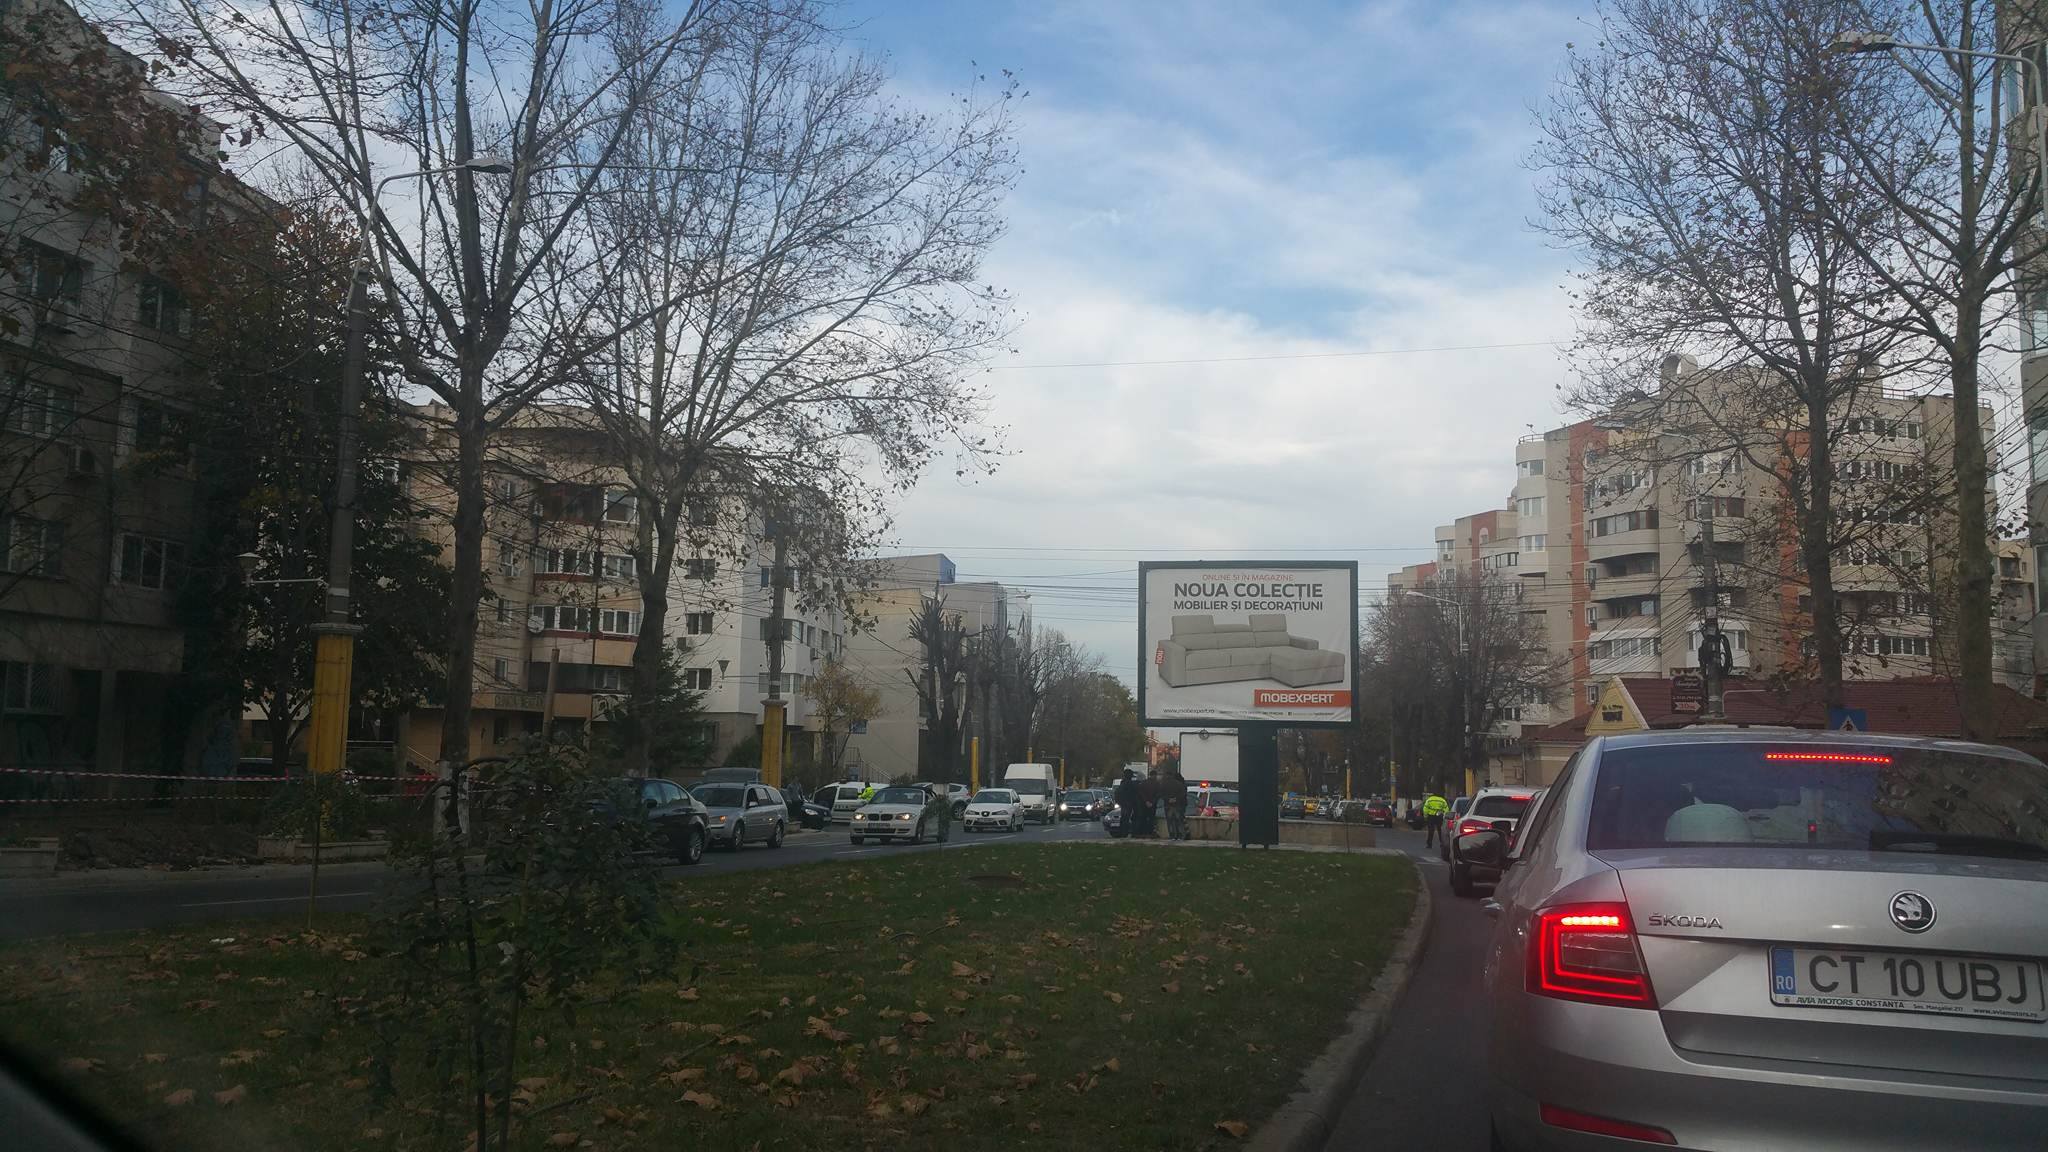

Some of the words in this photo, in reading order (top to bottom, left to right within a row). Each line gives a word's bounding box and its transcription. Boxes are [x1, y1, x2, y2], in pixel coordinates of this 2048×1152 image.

[1202, 574, 1230, 582] ONLINE
[1252, 574, 1295, 582] MAGAZINE
[1173, 582, 1229, 598] NOUA
[1234, 582, 1323, 601] COLECȚIE
[1173, 600, 1228, 610] MOBILIER
[1244, 601, 1323, 613] DECORAȚIUNI
[1260, 692, 1336, 704] MOBEXPERT
[1776, 975, 1795, 991] RO
[1808, 955, 1866, 994] CT
[1884, 958, 1927, 998] 10
[1936, 960, 2028, 1004] UBJ
[1817, 998, 1854, 1006] MOTORS
